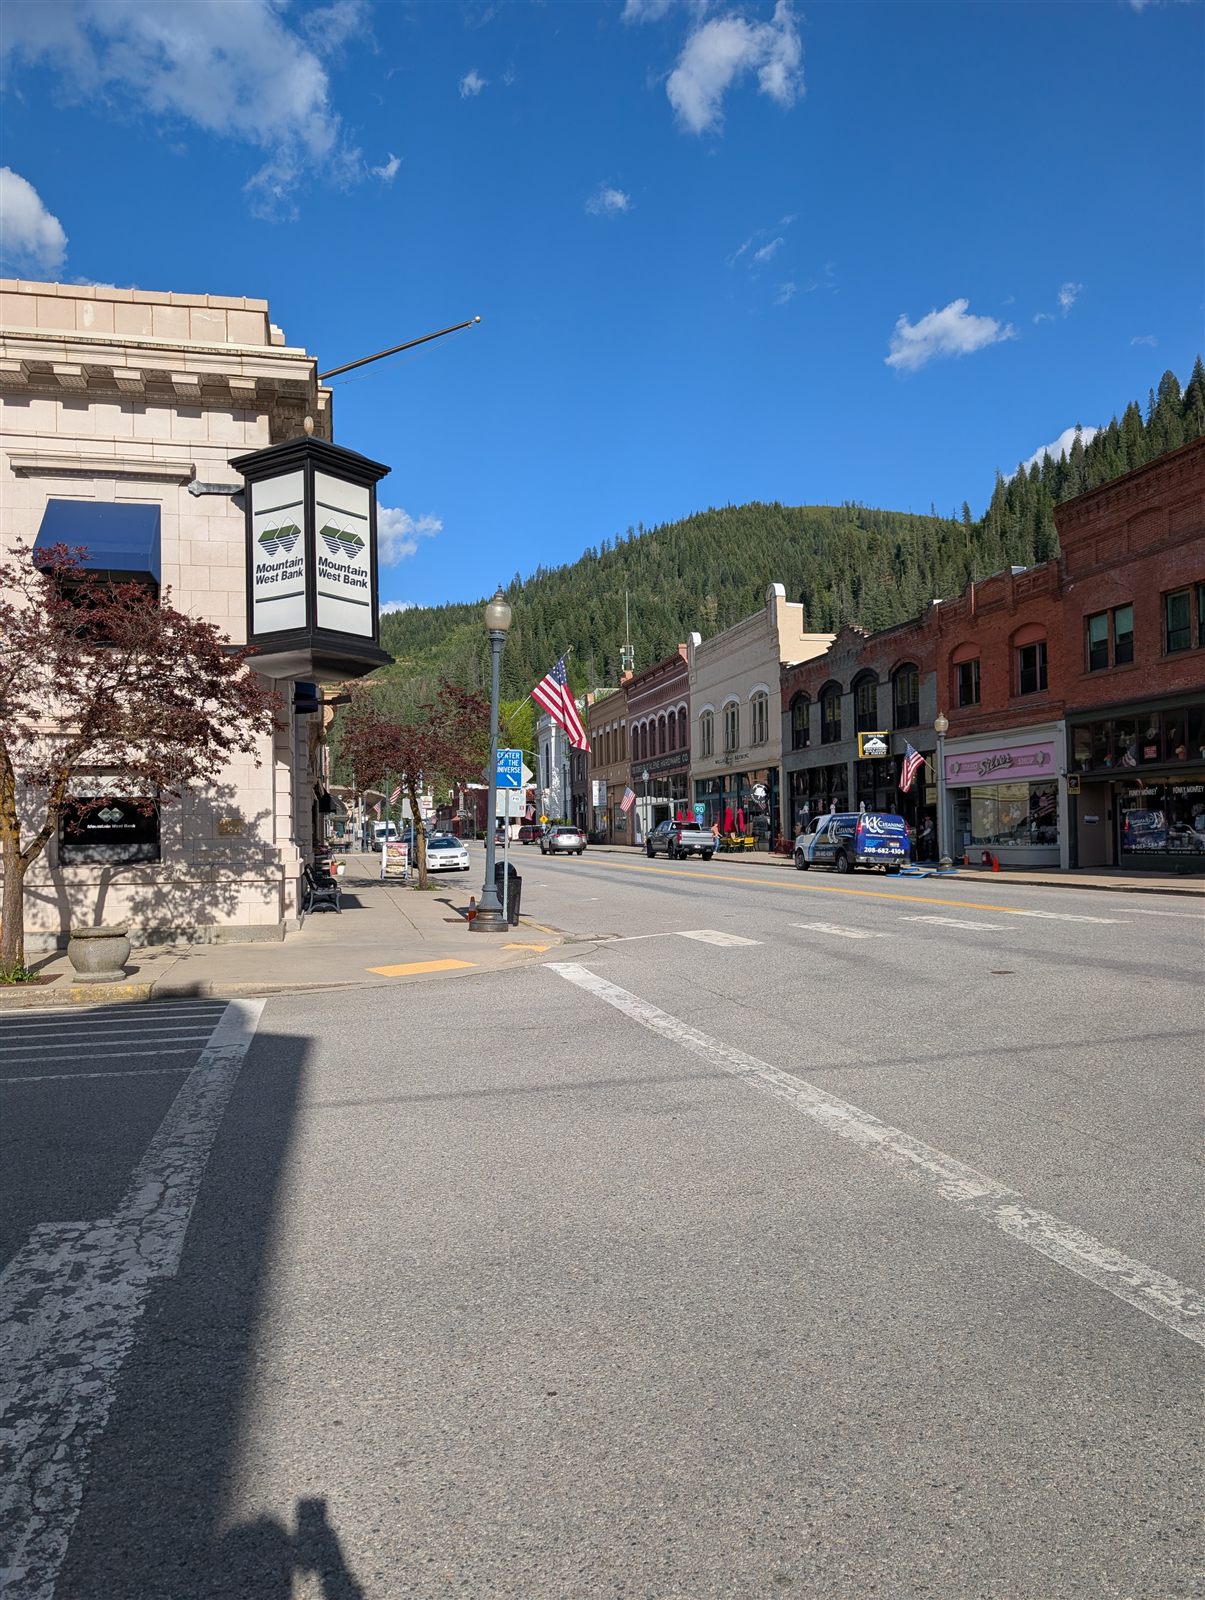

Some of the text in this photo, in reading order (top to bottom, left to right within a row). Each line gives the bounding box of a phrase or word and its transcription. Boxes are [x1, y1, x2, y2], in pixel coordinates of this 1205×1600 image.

[256, 556, 303, 574] Mountain
[319, 556, 368, 577] Mountain
[256, 567, 304, 585] West Bank
[318, 567, 368, 588] West Bank
[1186, 785, 1204, 793] MONKEY
[864, 847, 905, 855] 208-682-4304
